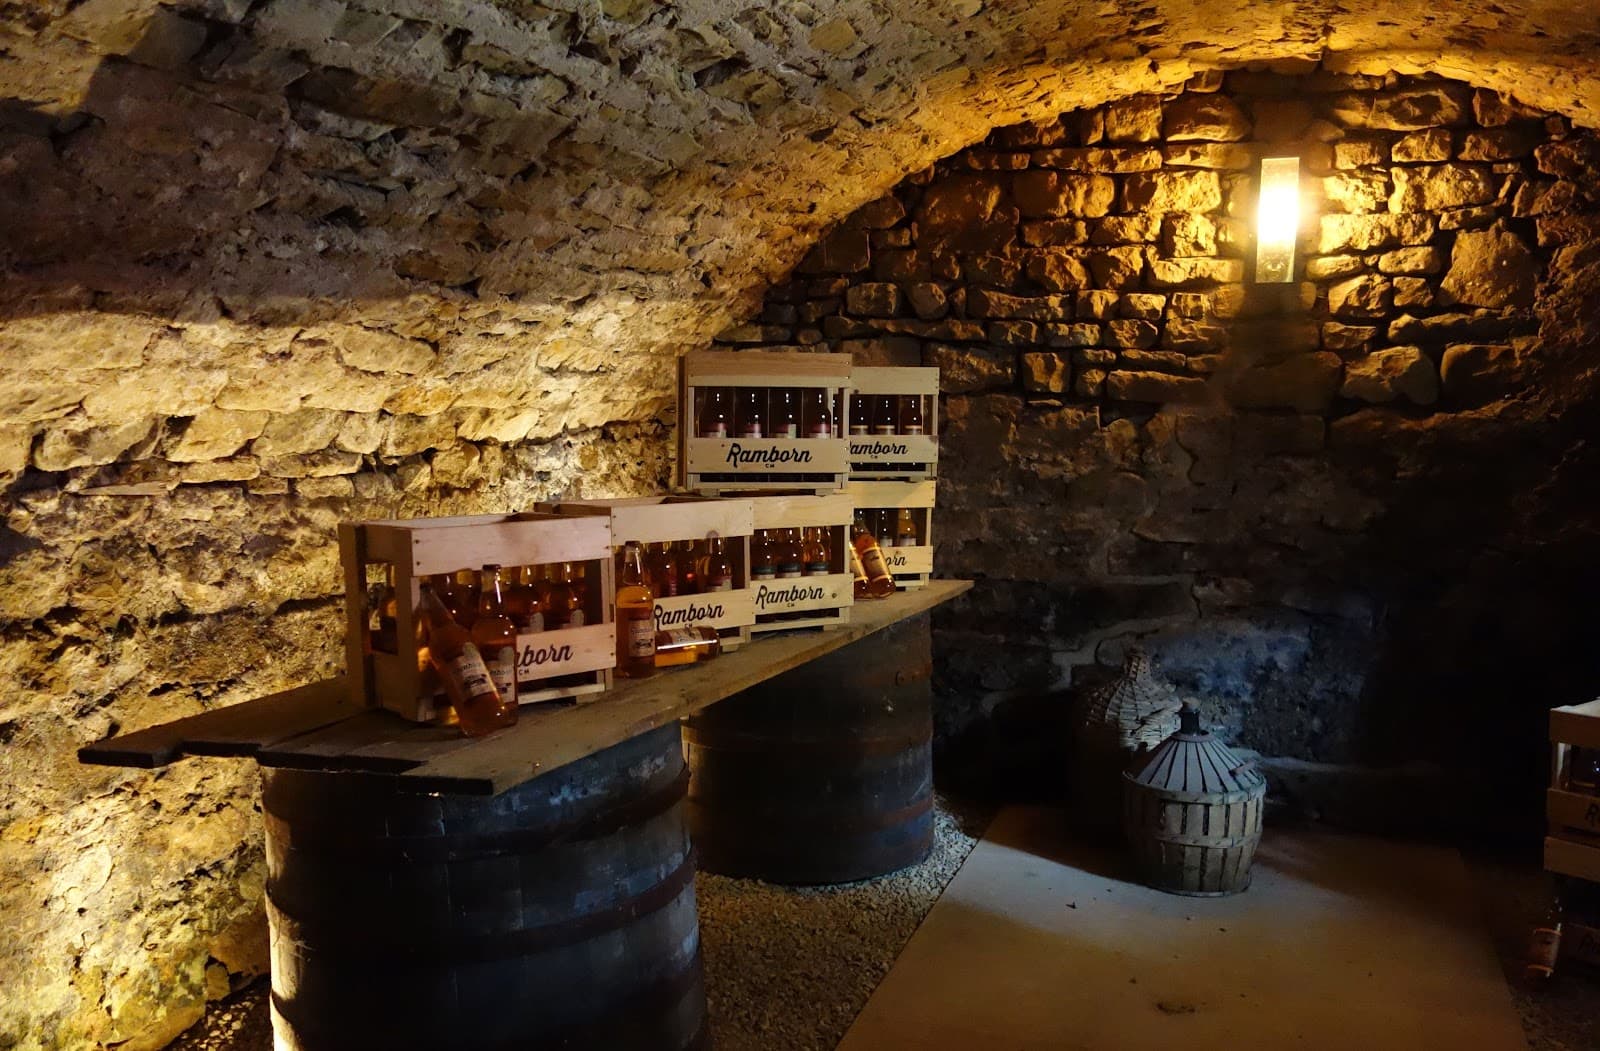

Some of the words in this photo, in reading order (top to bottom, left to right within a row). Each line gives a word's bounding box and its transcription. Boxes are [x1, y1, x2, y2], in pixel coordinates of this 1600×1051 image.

[726, 442, 812, 469] Ramborn
[850, 441, 908, 455] amborn
[755, 584, 826, 609] Ramborn
[654, 603, 725, 631] Ramborn
[516, 642, 574, 667] born
